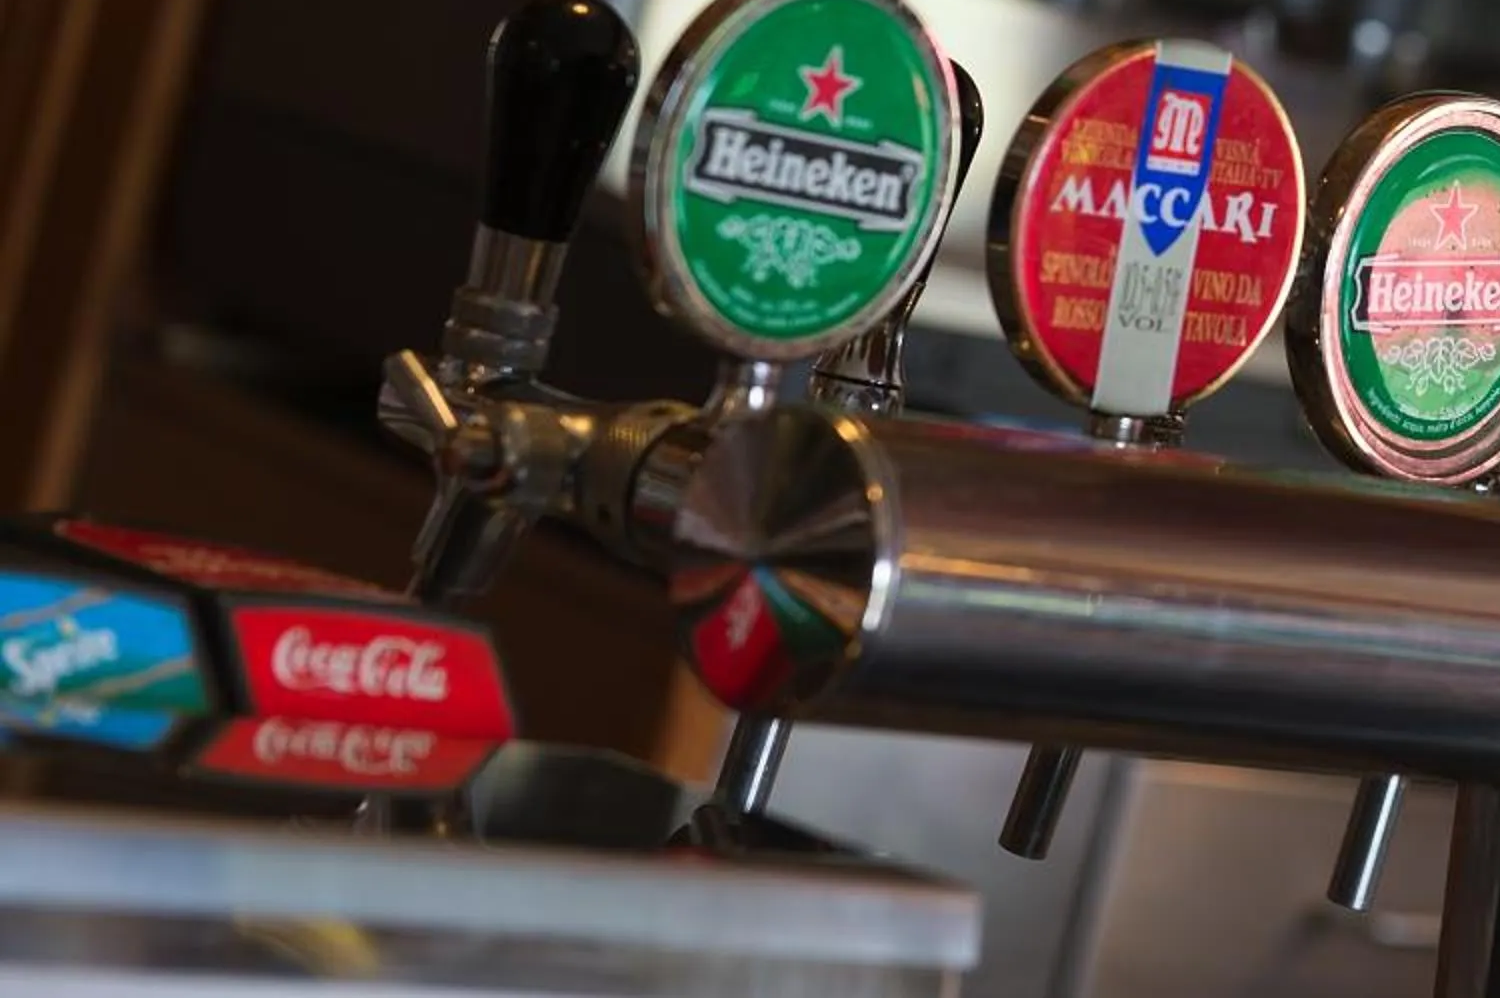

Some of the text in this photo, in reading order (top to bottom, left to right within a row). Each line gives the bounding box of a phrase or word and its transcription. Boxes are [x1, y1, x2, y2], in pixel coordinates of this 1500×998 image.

[705, 128, 900, 209] Heineken
[1050, 175, 1278, 243] MACCARI
[1195, 271, 1235, 301] VINO
[1236, 274, 1261, 305] DA
[1119, 314, 1172, 332] VOL
[1185, 312, 1246, 345] TAVOLA
